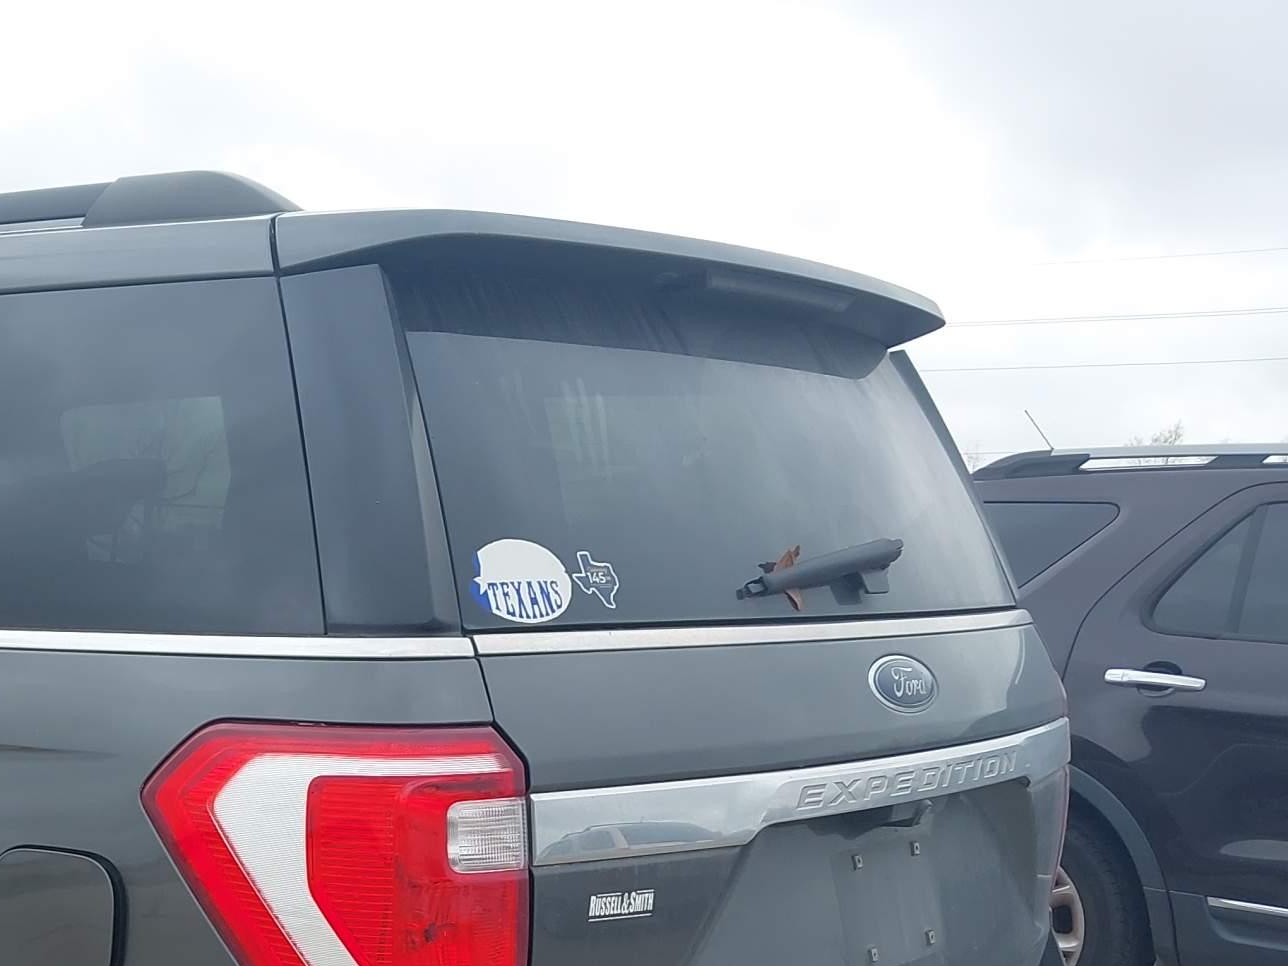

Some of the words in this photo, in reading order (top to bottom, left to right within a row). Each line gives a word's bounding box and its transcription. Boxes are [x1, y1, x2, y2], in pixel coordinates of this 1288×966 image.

[586, 571, 607, 584] 145
[487, 579, 563, 620] TEXANS
[891, 667, 928, 698] Ford
[795, 750, 1018, 811] EXPEDITION
